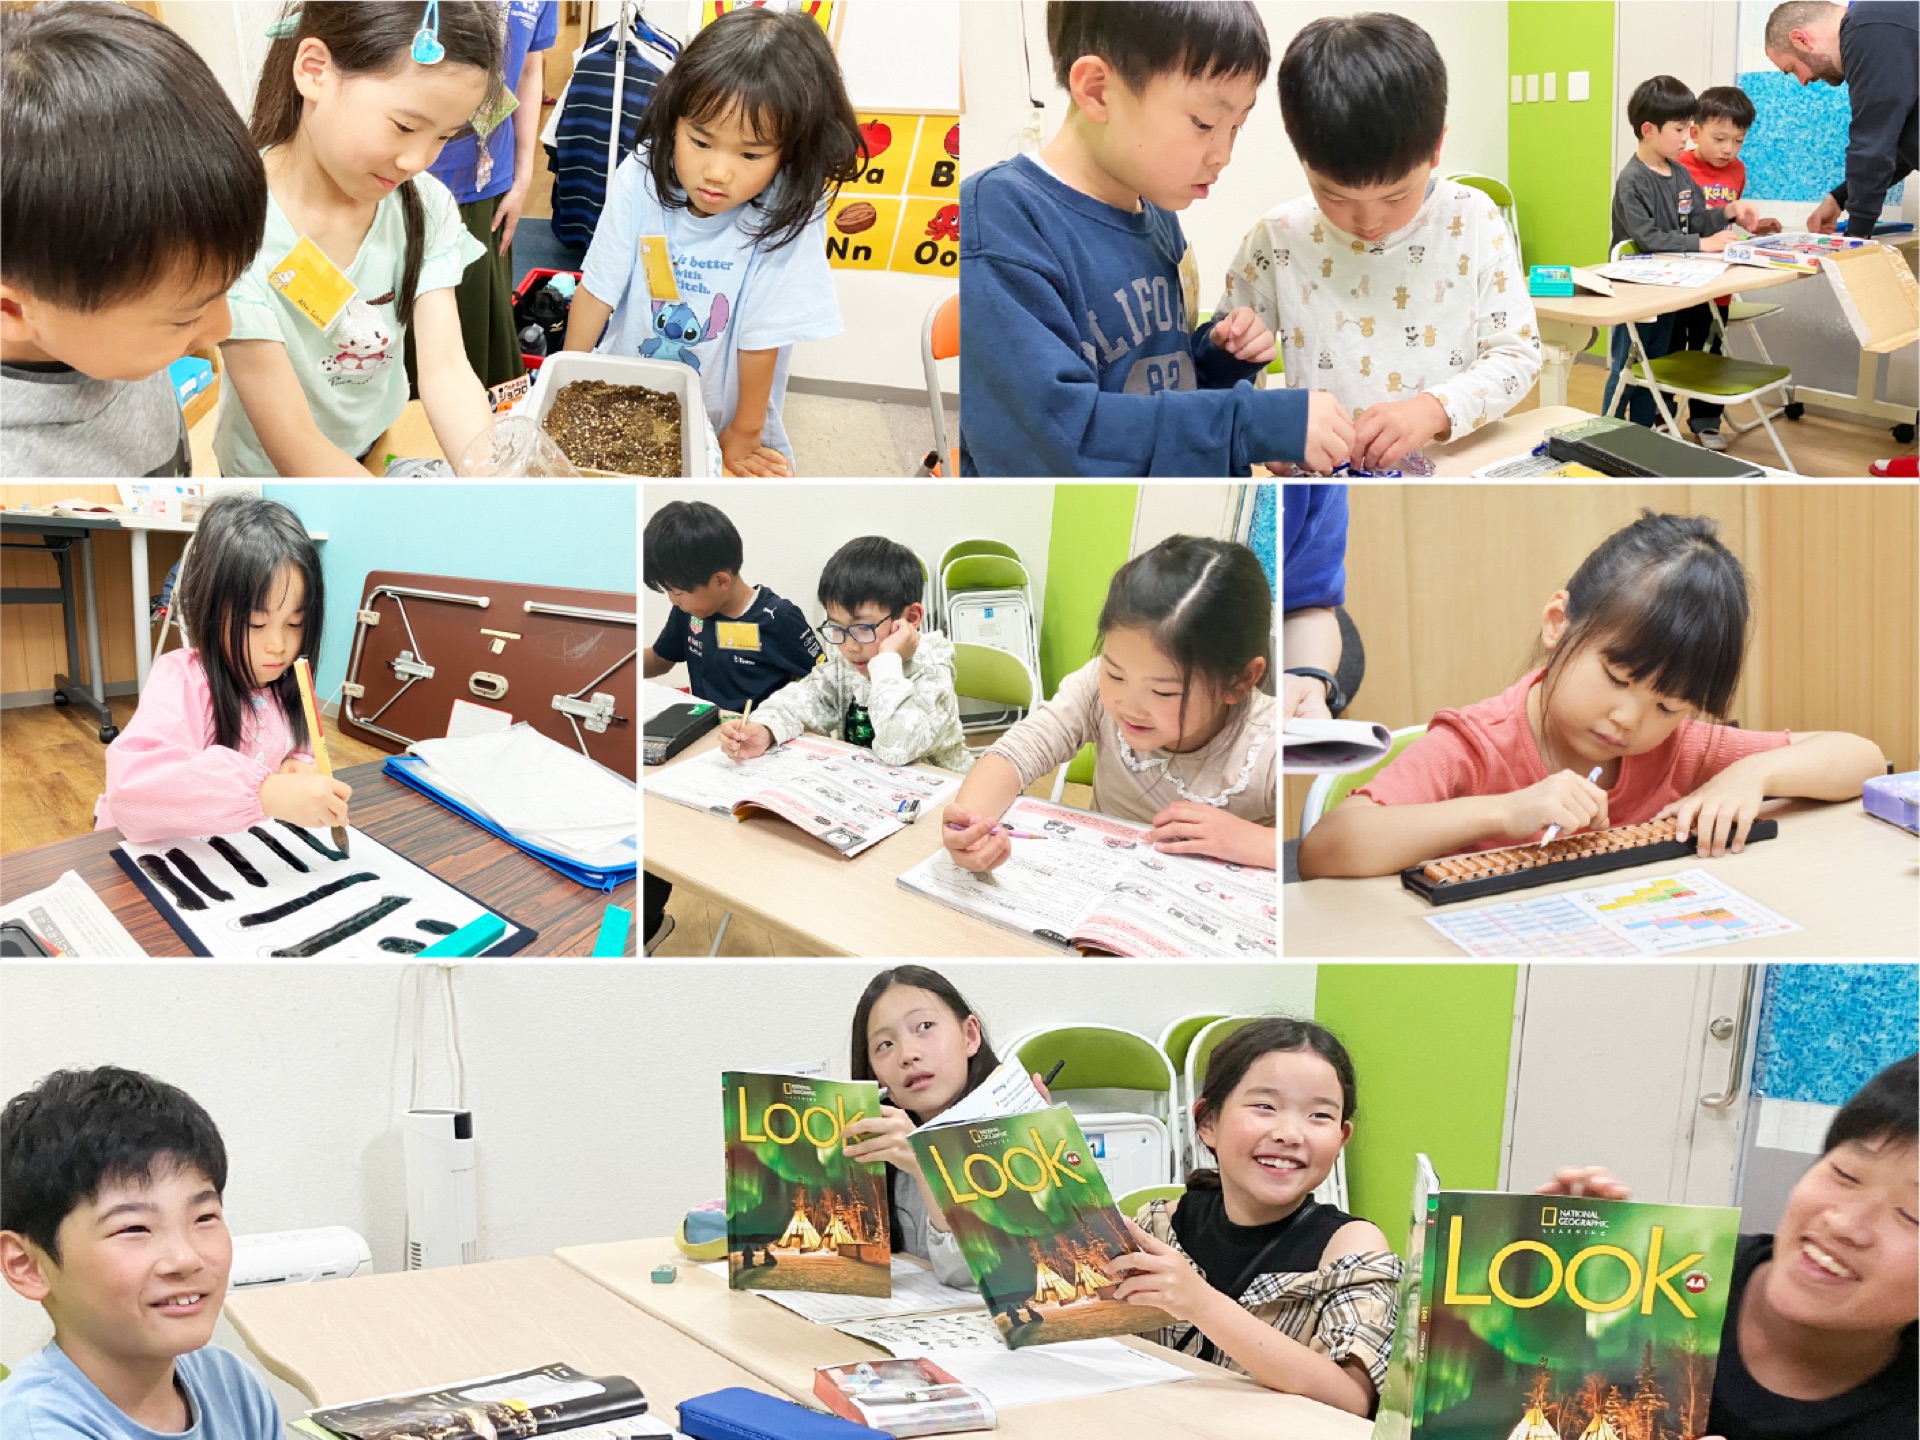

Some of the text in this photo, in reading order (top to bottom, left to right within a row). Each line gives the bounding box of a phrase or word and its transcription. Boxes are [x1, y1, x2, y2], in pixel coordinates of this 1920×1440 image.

[827, 236, 873, 262] Nn
[914, 241, 958, 268] Oo
[690, 256, 734, 271] better
[677, 279, 711, 295] itch.
[738, 1086, 866, 1149] Look
[928, 1127, 1089, 1204] Look
[1558, 1217, 1610, 1229] GEOGRAPHIC
[1559, 1209, 1600, 1219] NATIONAL
[1444, 1214, 1706, 1319] Look
[1686, 1277, 1706, 1289] 4A
